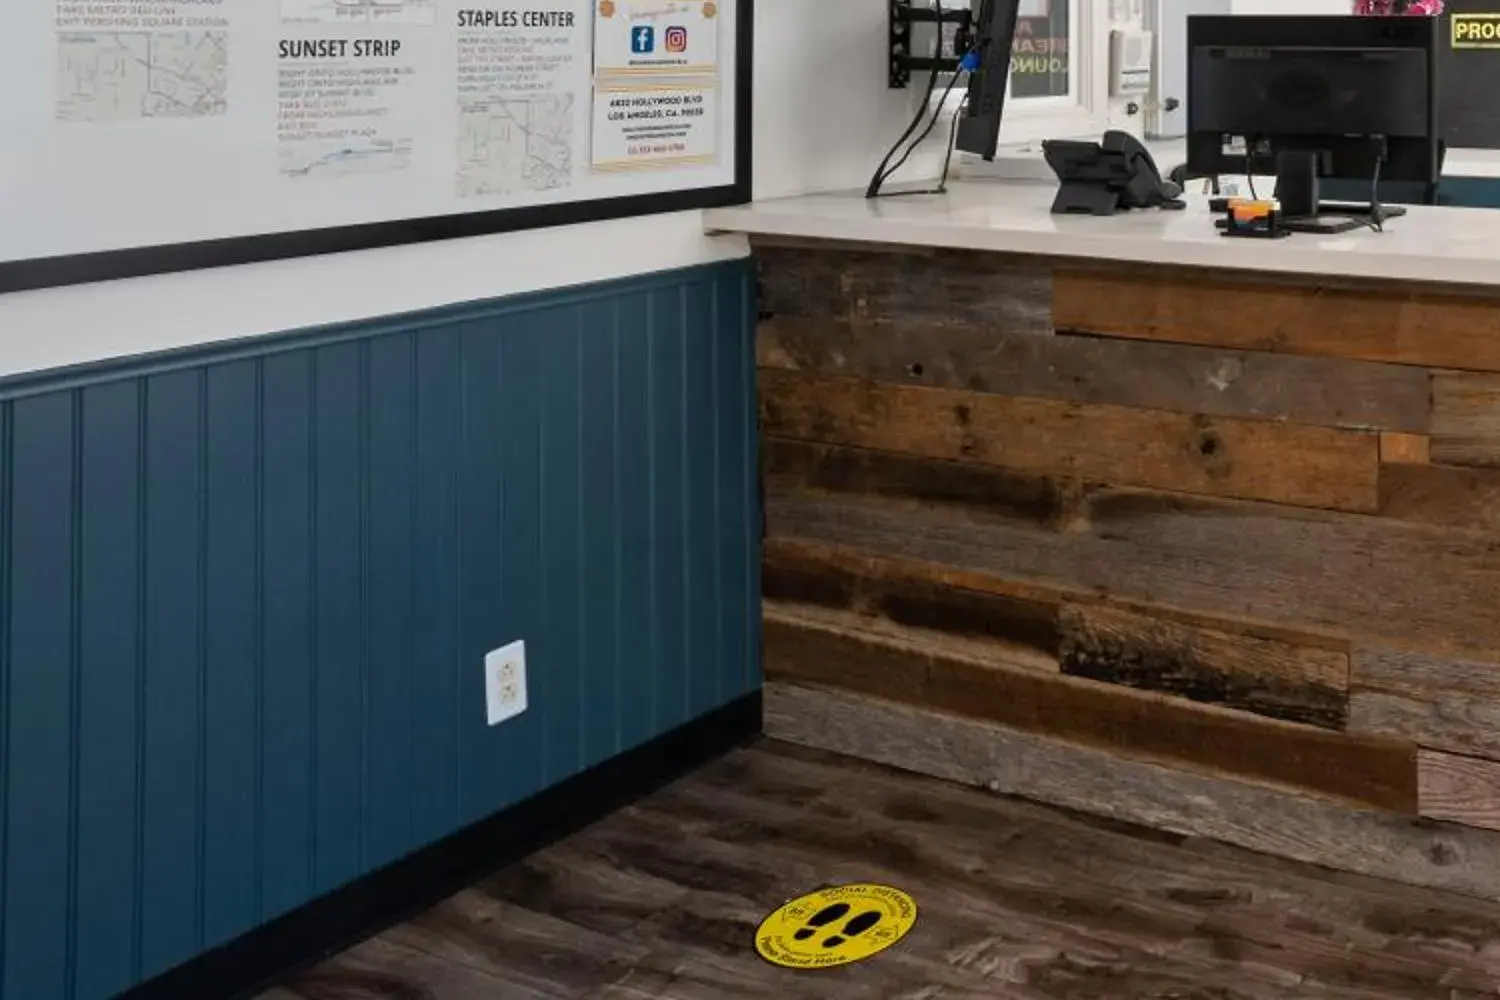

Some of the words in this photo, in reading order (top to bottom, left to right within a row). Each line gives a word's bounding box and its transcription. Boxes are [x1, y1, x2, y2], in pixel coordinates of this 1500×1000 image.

[457, 9, 518, 27] STAPLES
[522, 9, 575, 28] CENTER
[278, 38, 348, 59] SUNSET
[353, 39, 401, 58] STRIP
